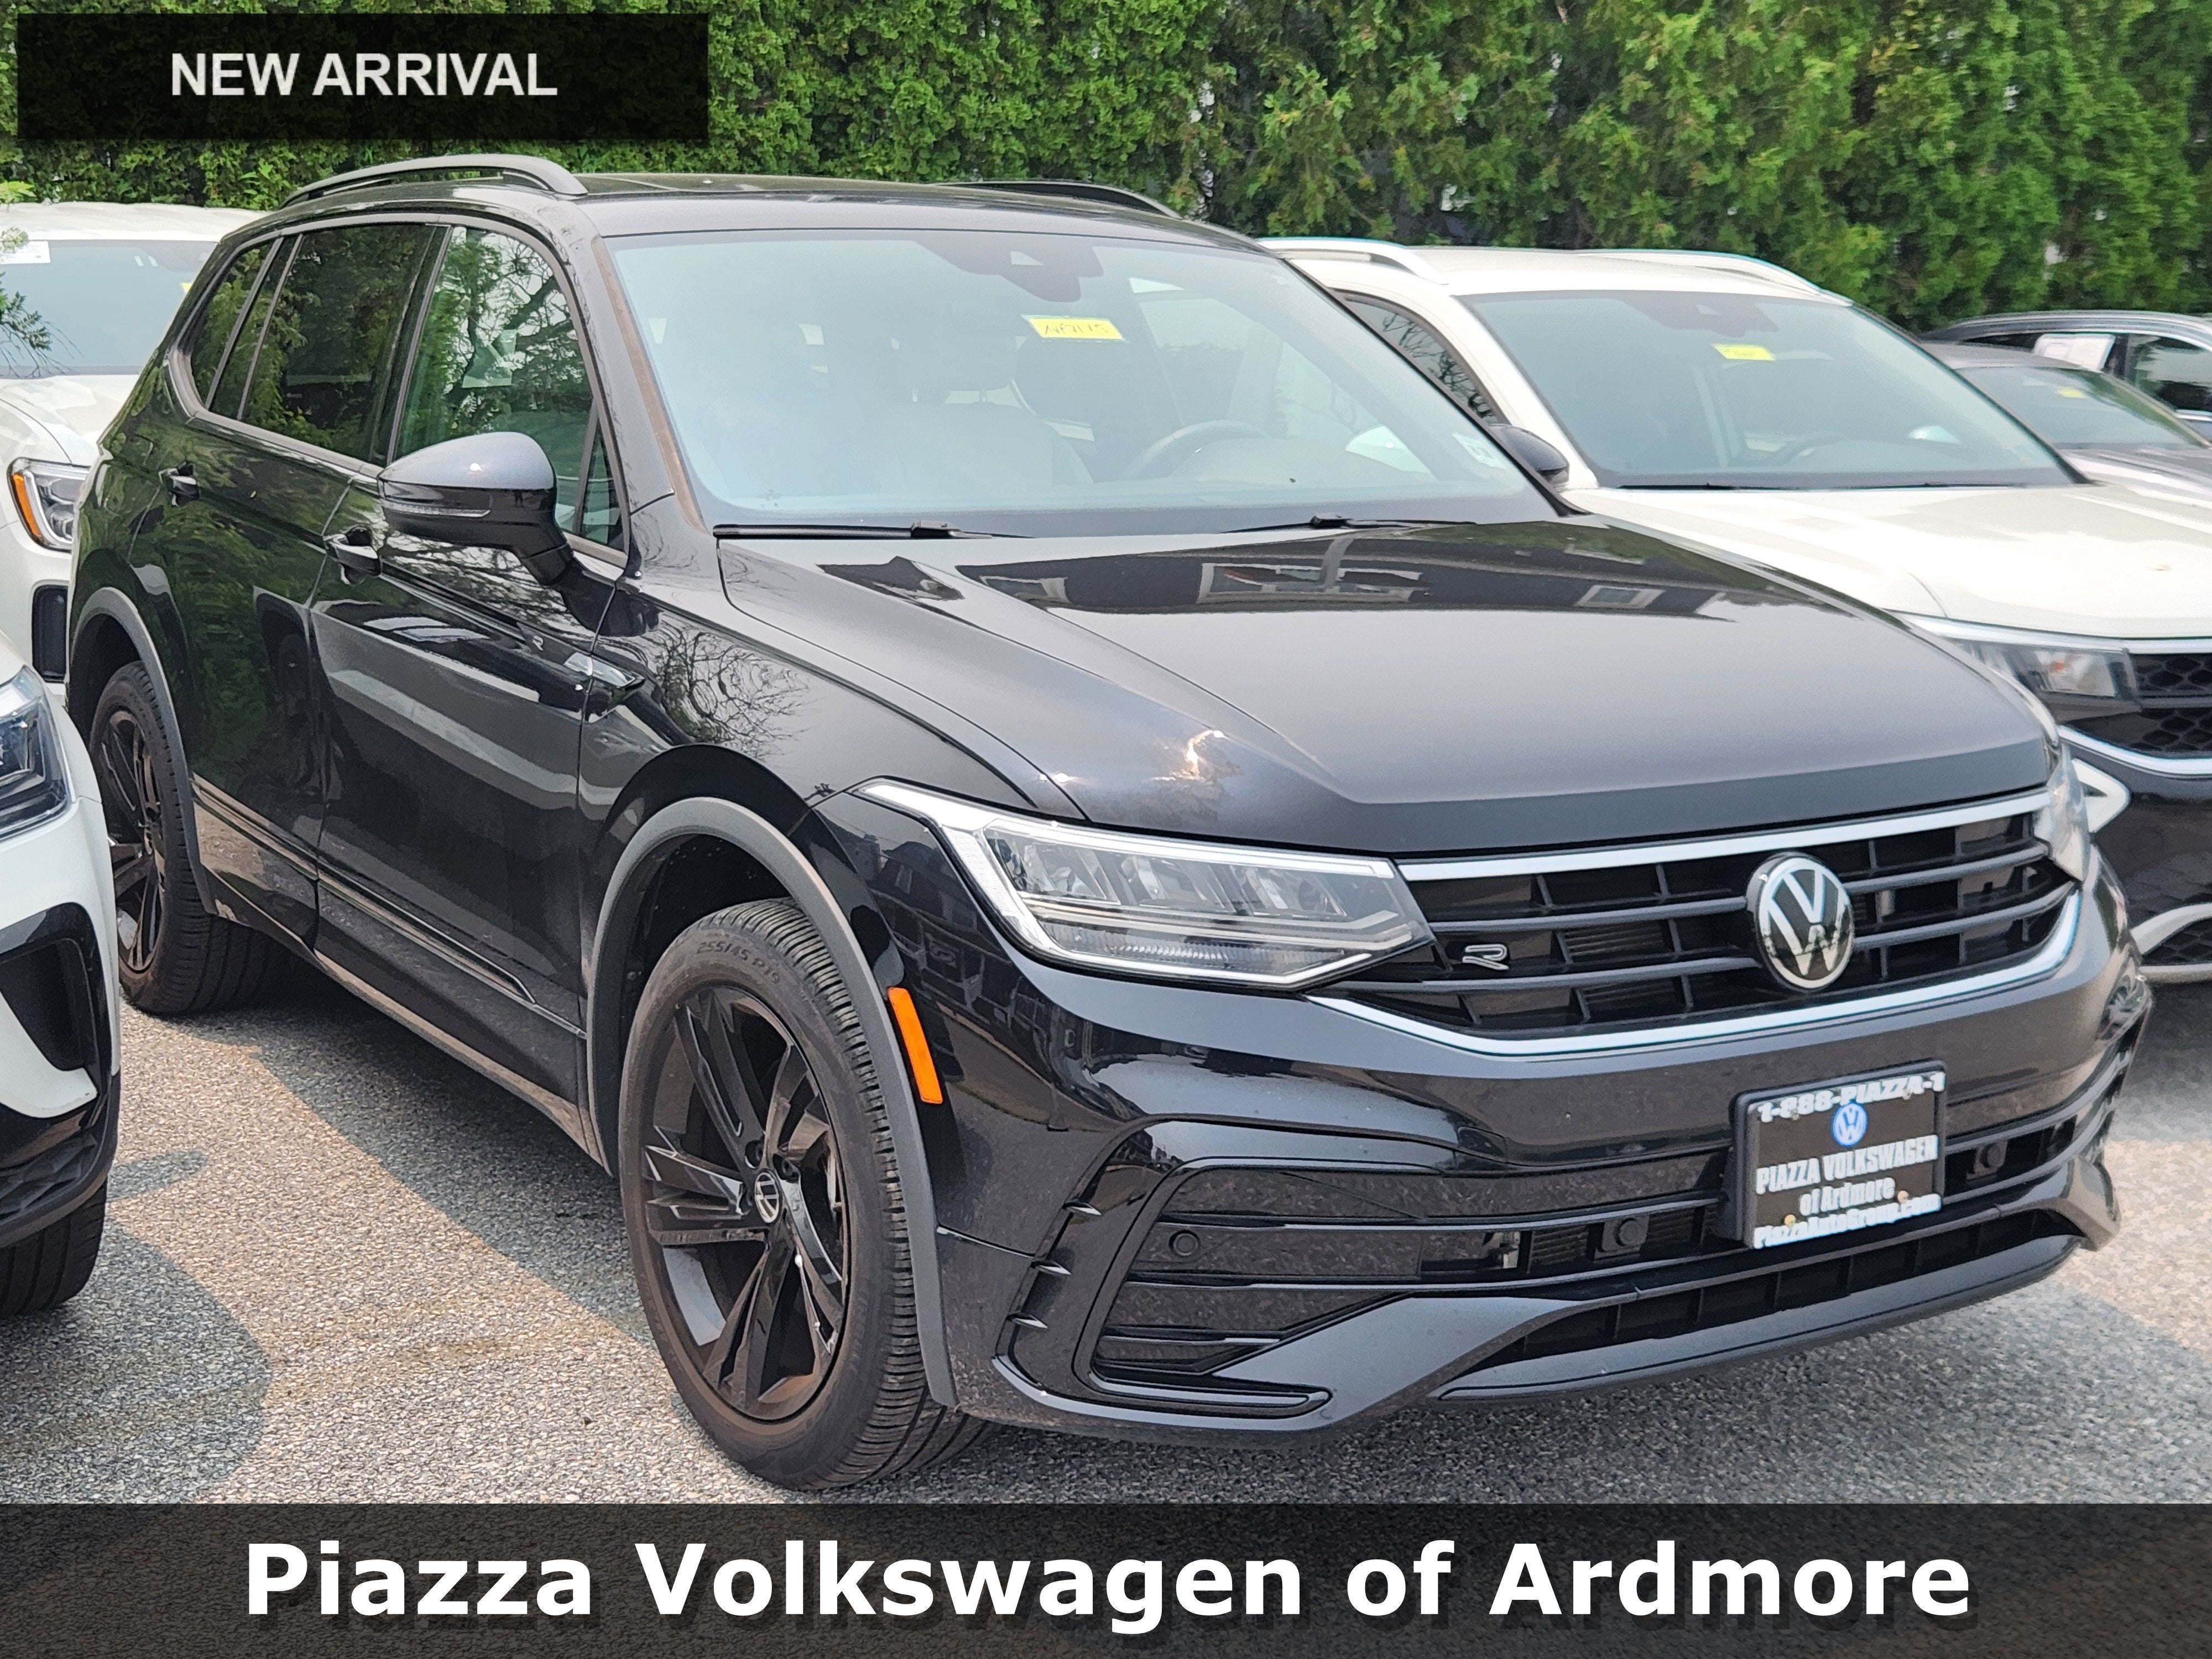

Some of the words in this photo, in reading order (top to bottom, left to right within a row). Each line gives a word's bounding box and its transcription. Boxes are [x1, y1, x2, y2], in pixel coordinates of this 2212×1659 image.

[1462, 943, 1510, 971] R
[1758, 1072, 1945, 1123] 1-888-PIAZZA-1
[1756, 1158, 1821, 1194] PIAZZA
[1823, 1135, 1939, 1181] VOLKSWAGEN
[1799, 1188, 1821, 1216] of
[1820, 1177, 1896, 1212] Ardmore
